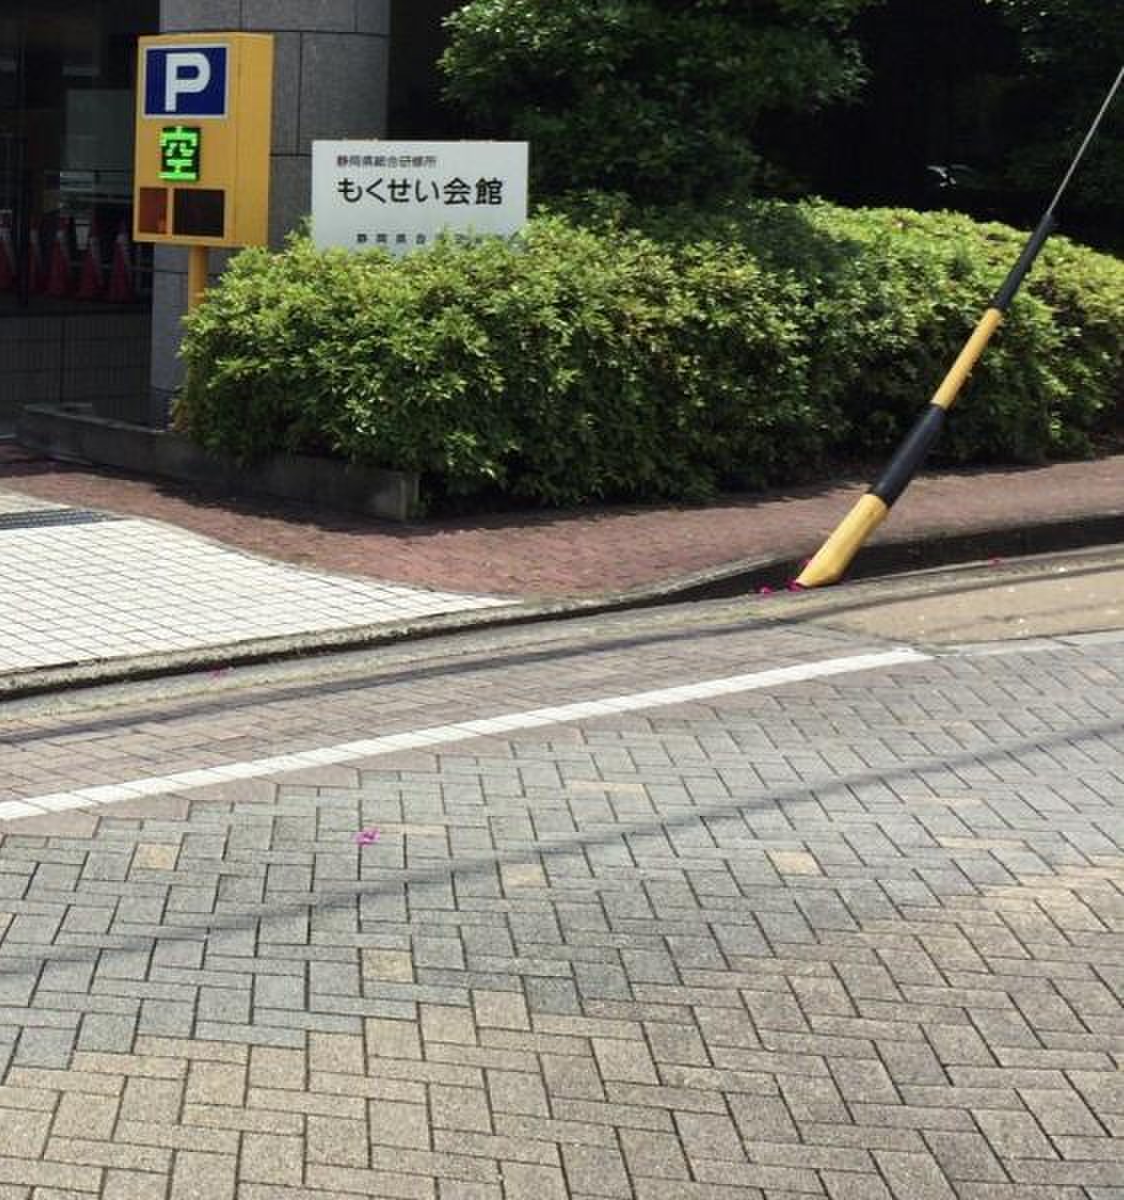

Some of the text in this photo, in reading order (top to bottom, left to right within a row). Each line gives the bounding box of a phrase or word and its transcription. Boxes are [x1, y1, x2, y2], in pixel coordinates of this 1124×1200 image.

[164, 52, 211, 112] P
[158, 126, 198, 181] 空
[337, 178, 503, 205] もくせい会館
